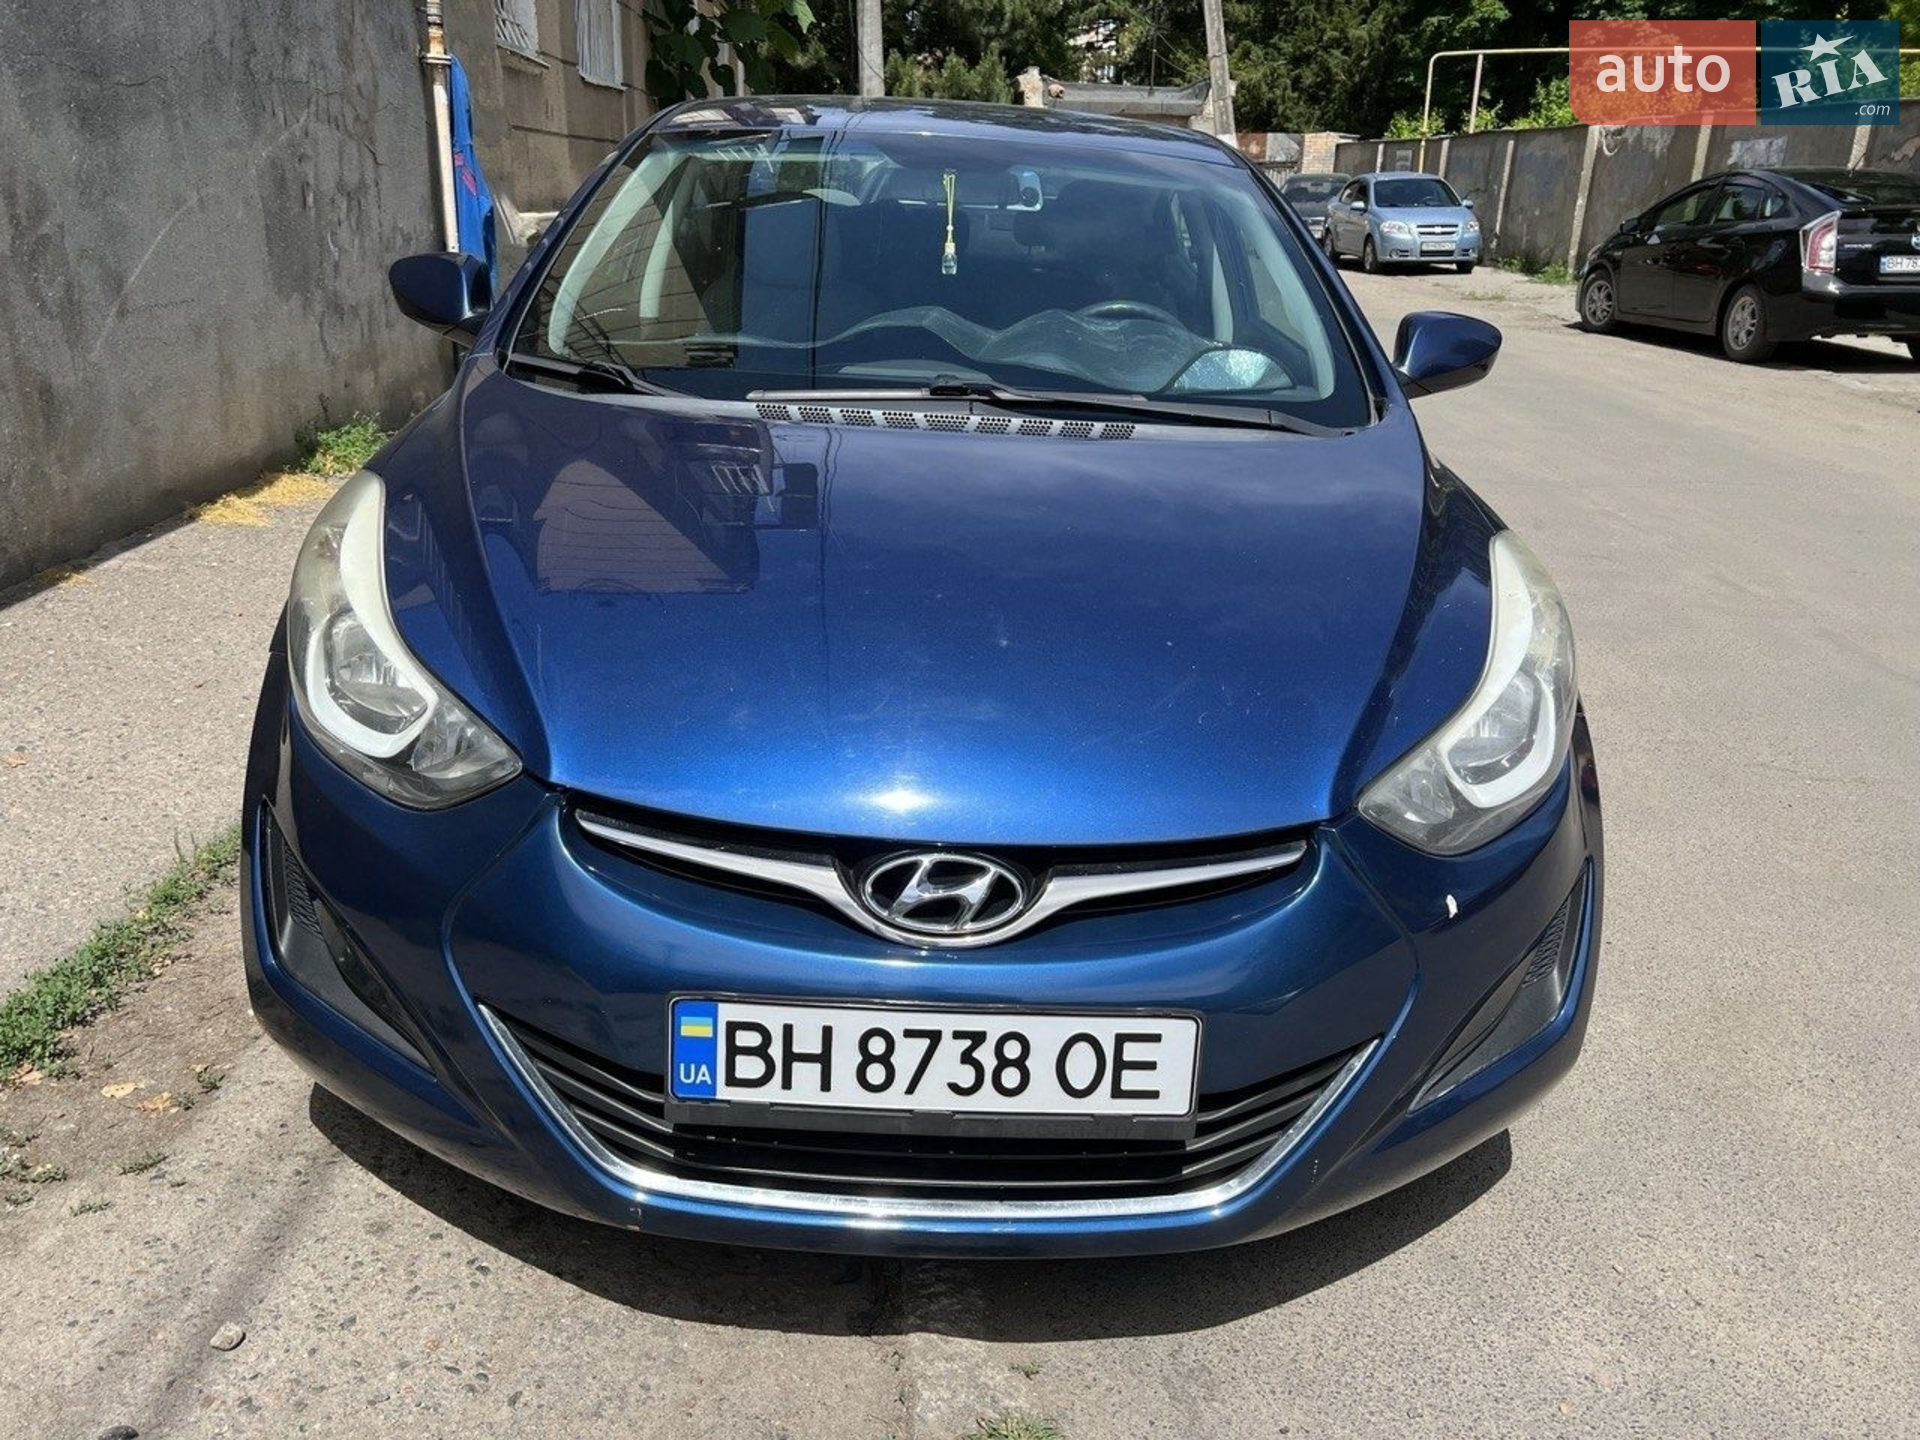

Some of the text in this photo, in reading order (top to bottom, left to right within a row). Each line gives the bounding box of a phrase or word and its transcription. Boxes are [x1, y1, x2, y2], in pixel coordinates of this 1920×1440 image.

[1886, 257, 1903, 269] BH
[725, 1020, 1163, 1100] BH 8738 OE
[680, 1063, 712, 1085] UA
